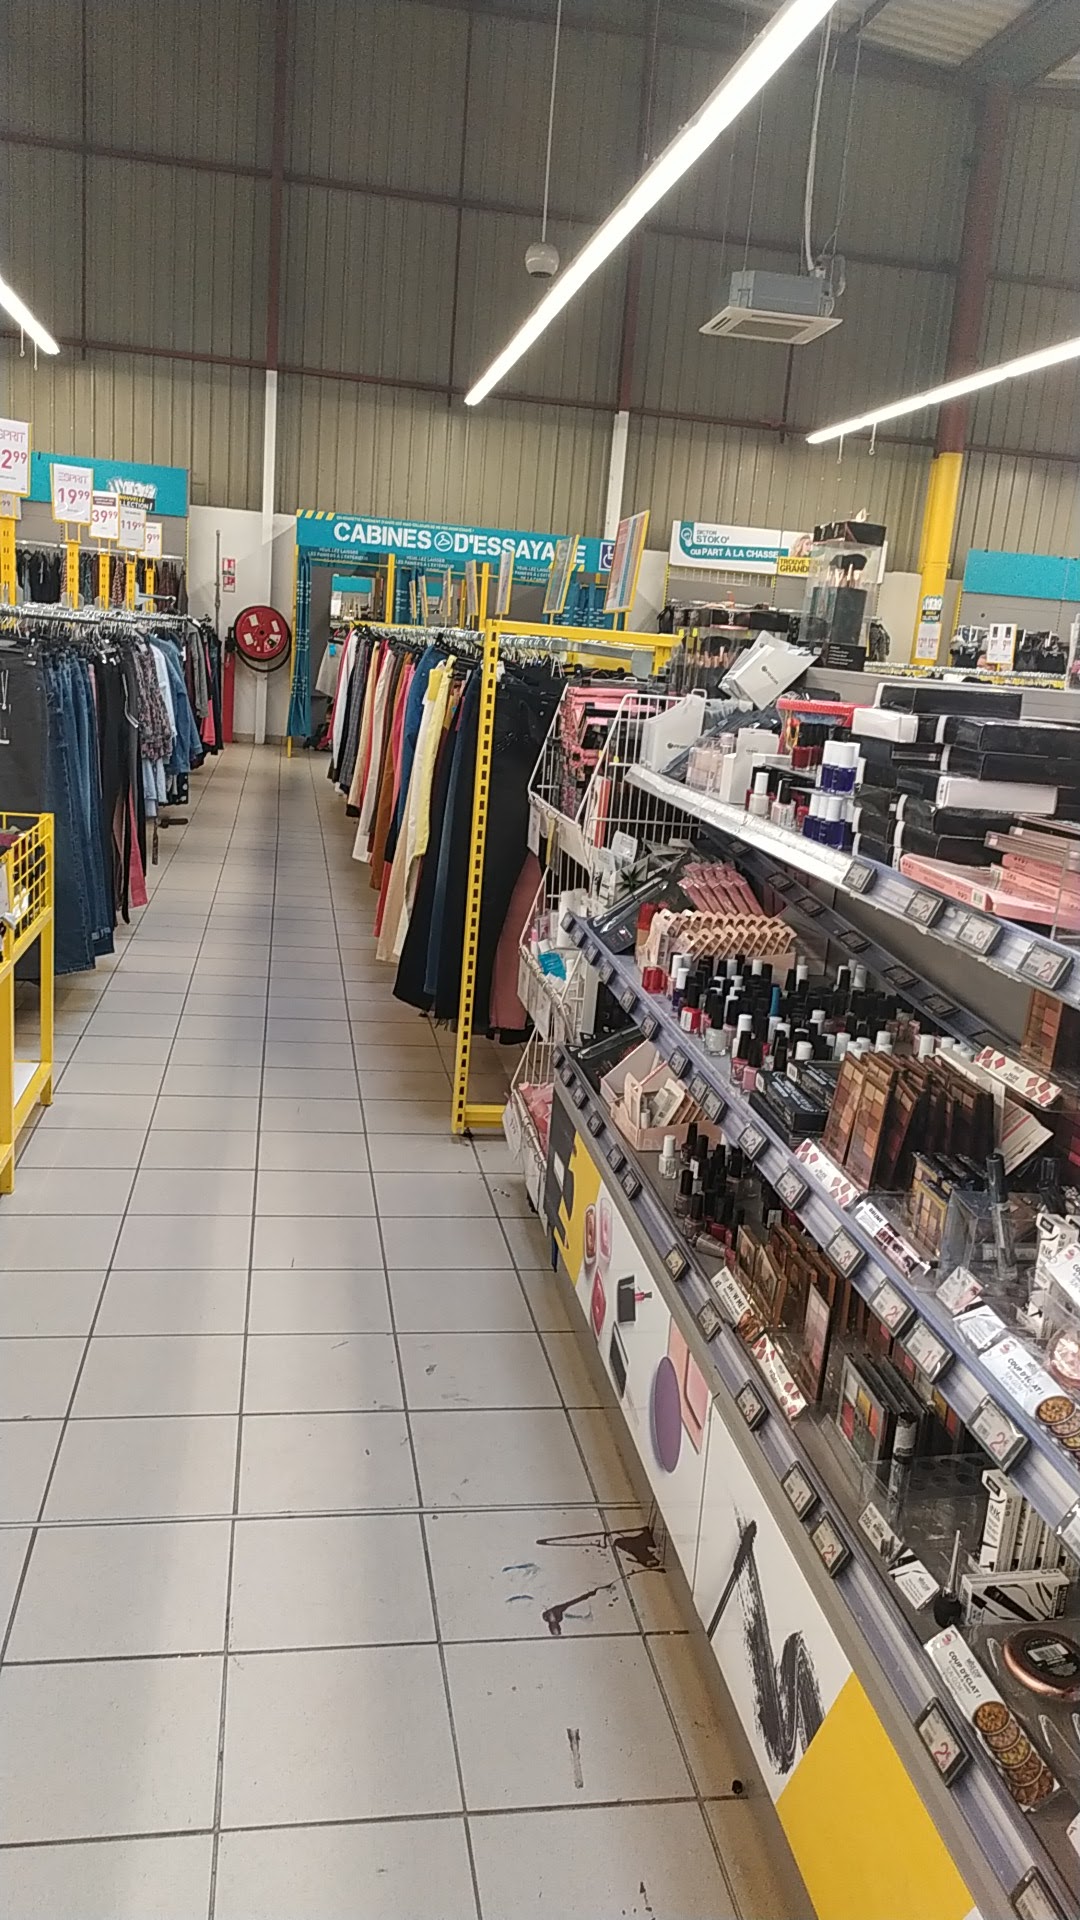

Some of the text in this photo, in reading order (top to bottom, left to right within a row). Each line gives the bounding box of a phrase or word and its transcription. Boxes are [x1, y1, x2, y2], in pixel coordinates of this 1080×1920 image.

[58, 471, 90, 484] ESPRIT
[333, 522, 433, 549] CABINES
[453, 533, 587, 565] D'ESSAYAGE
[702, 548, 724, 557] PART
[725, 547, 732, 557] À
[733, 549, 745, 558] LA
[746, 549, 779, 559] CHASSE
[780, 558, 806, 566] TROUVE
[868, 1207, 884, 1223] BRUME
[948, 1651, 963, 1669] COUP
[959, 1668, 980, 1695] D'ÉCLAT
